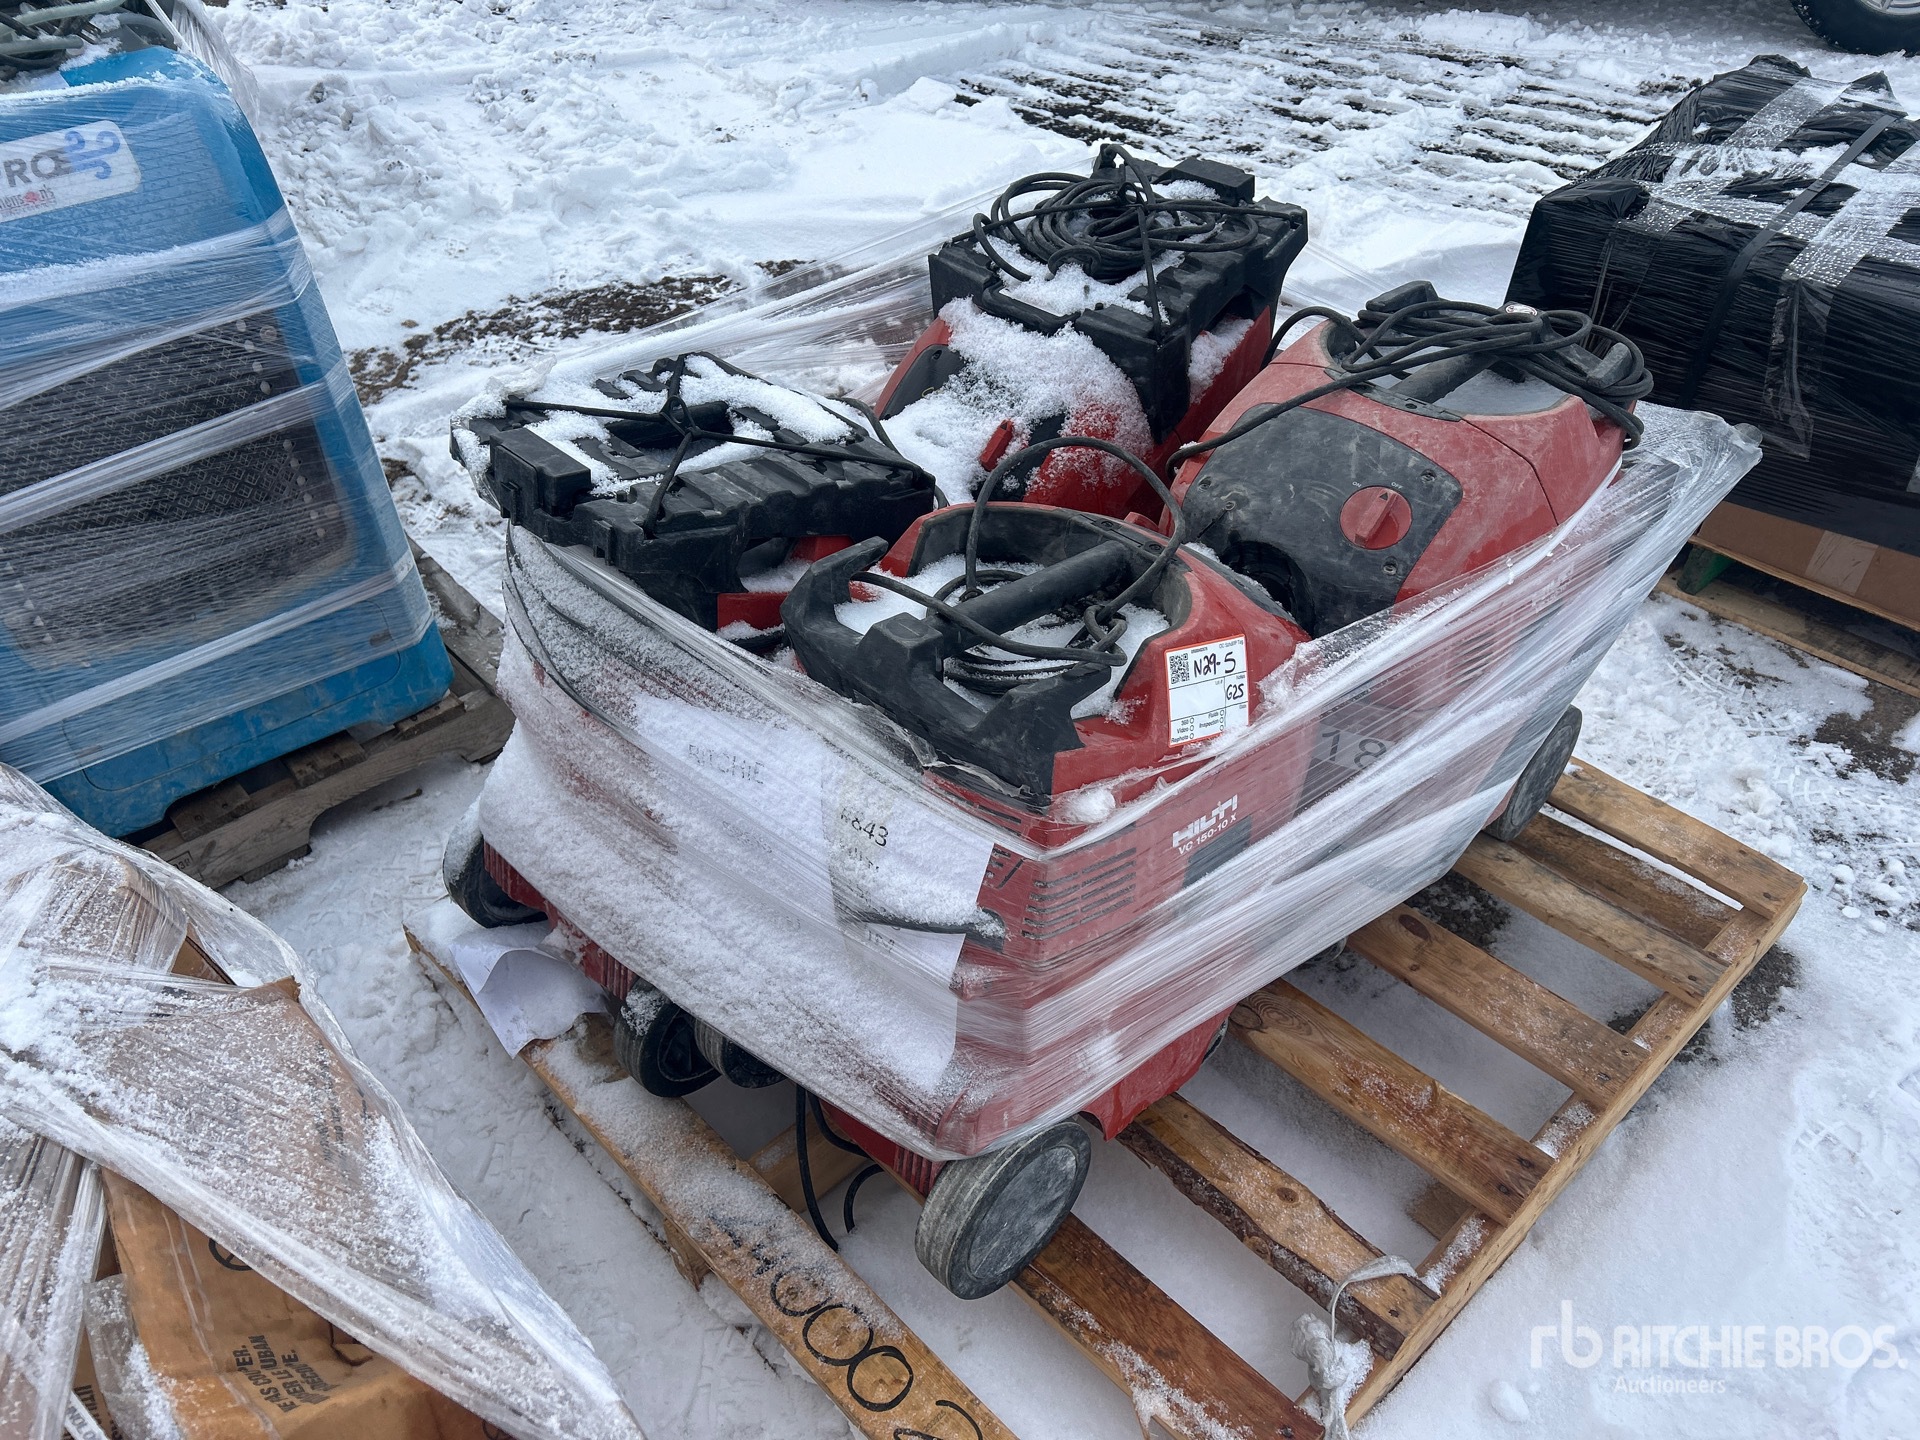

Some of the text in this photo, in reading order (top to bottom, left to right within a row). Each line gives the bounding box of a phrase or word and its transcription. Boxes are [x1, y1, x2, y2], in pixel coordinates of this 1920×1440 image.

[1172, 793, 1238, 848] HILTI
[1178, 811, 1237, 855] VC 150-10 X
[248, 1335, 278, 1371] UBAN
